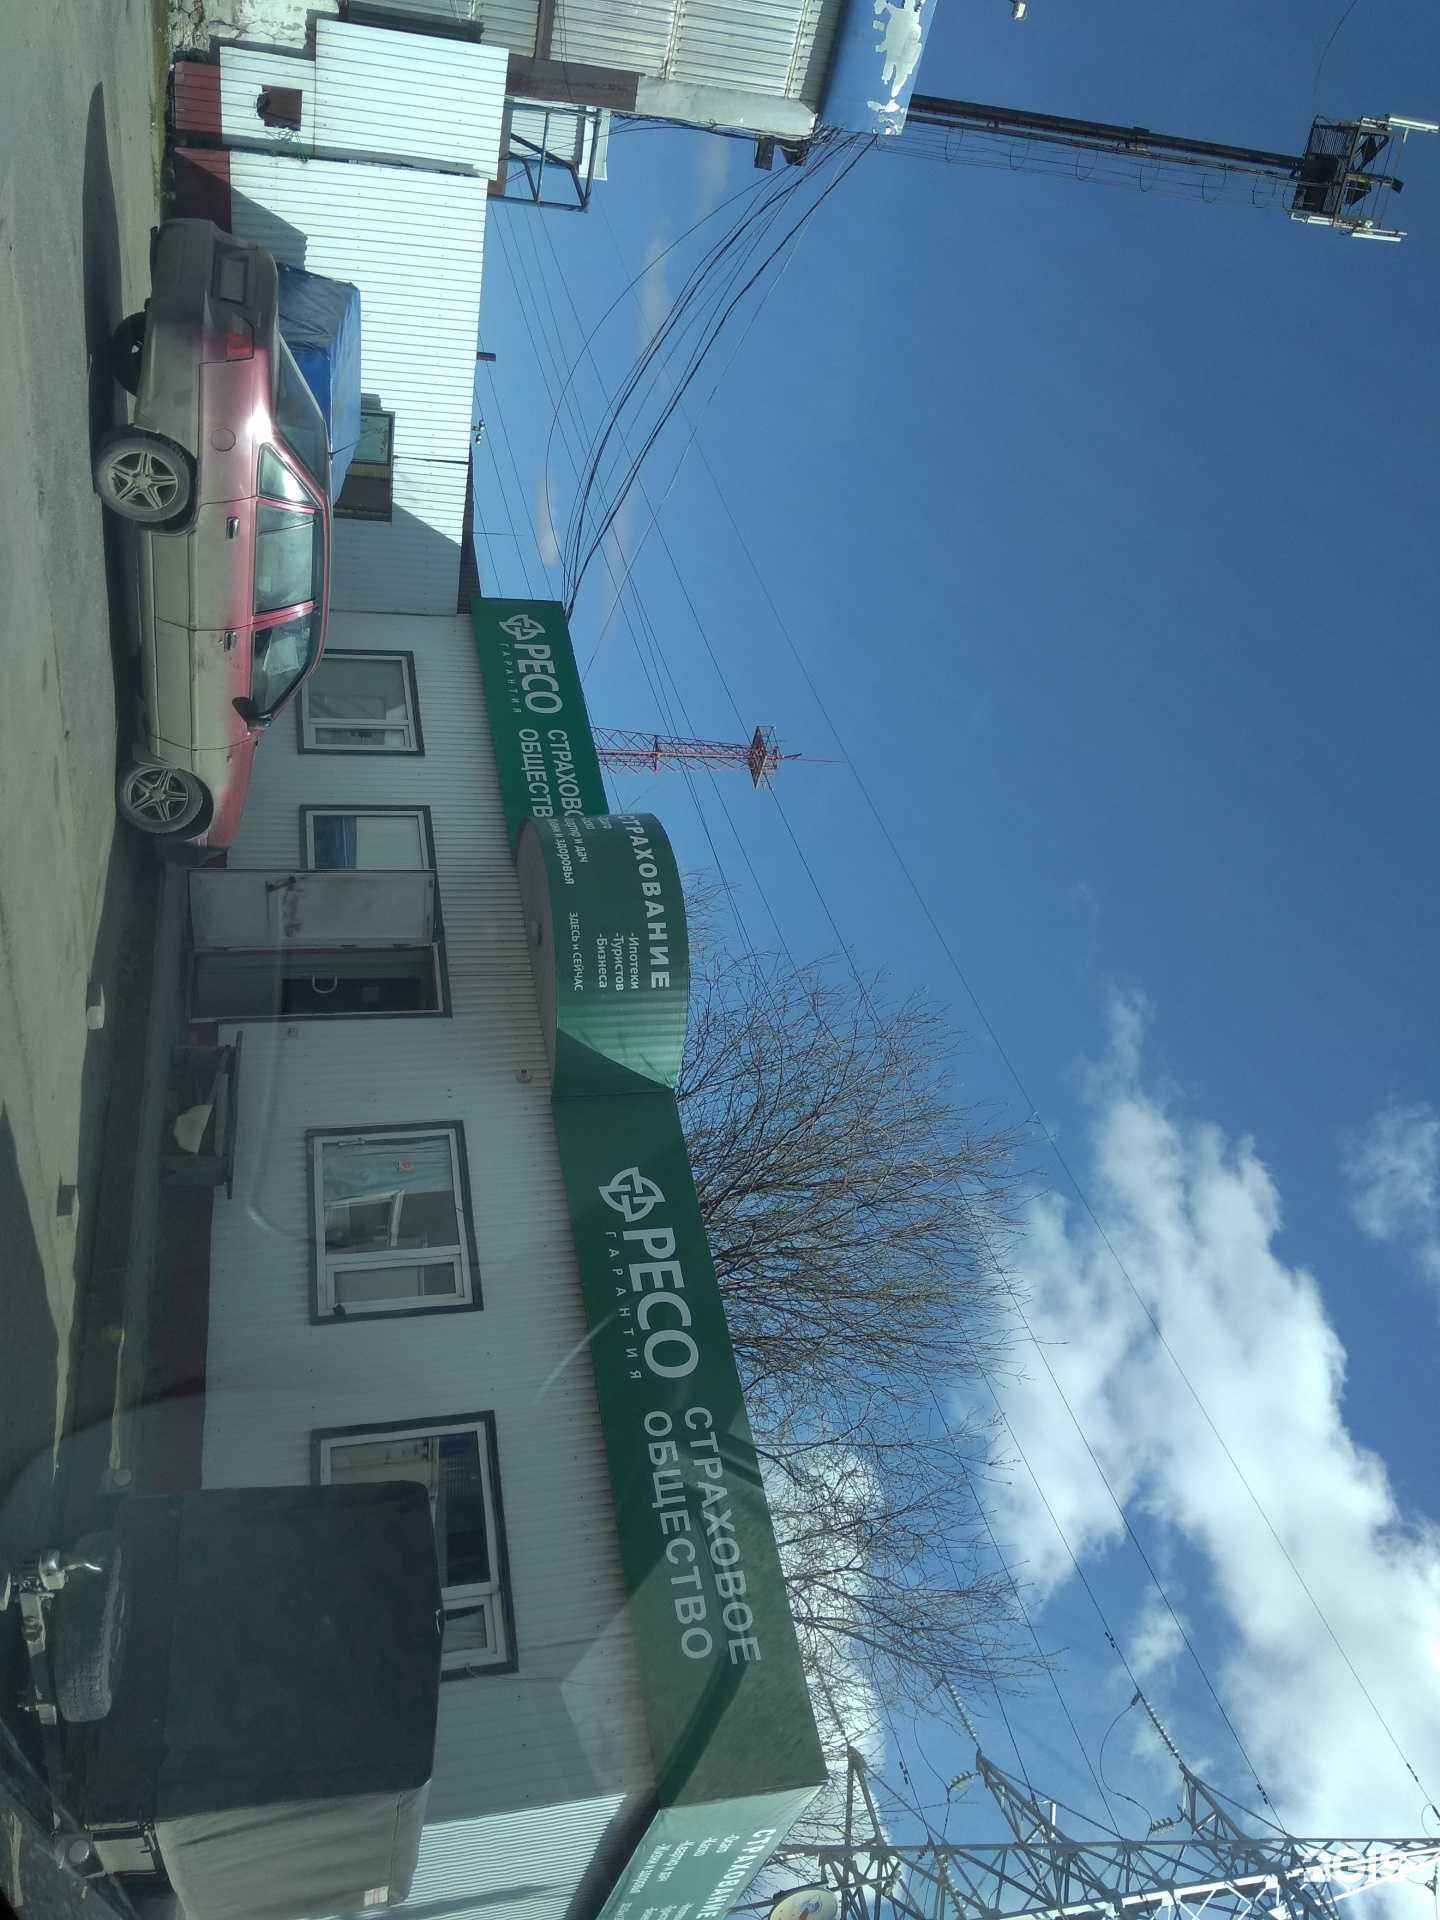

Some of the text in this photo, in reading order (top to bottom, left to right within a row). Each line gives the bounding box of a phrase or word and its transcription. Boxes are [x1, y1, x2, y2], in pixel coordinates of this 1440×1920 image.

[500, 644, 522, 713] ГАРАНТИЯ
[514, 643, 564, 714] РЕСО
[555, 839, 575, 884] здоровья
[574, 846, 589, 863] дач
[568, 912, 580, 942] ЗДЕСЬ
[618, 816, 670, 988] СТРАХОВАНИЕ
[572, 952, 584, 991] СЕЙЧАС
[596, 933, 608, 988] -Бизнеса
[611, 932, 624, 991] -Туристов
[627, 932, 640, 990] -Ипотеки
[605, 1232, 642, 1380] ГАРАНТИЯ
[623, 1228, 699, 1378] РЕСО
[644, 1410, 712, 1660] ОБЩЕСТВО
[684, 1406, 762, 1665] СТРАХОВОЕ
[696, 1828, 776, 1919] СТРАХОВАНИЕ
